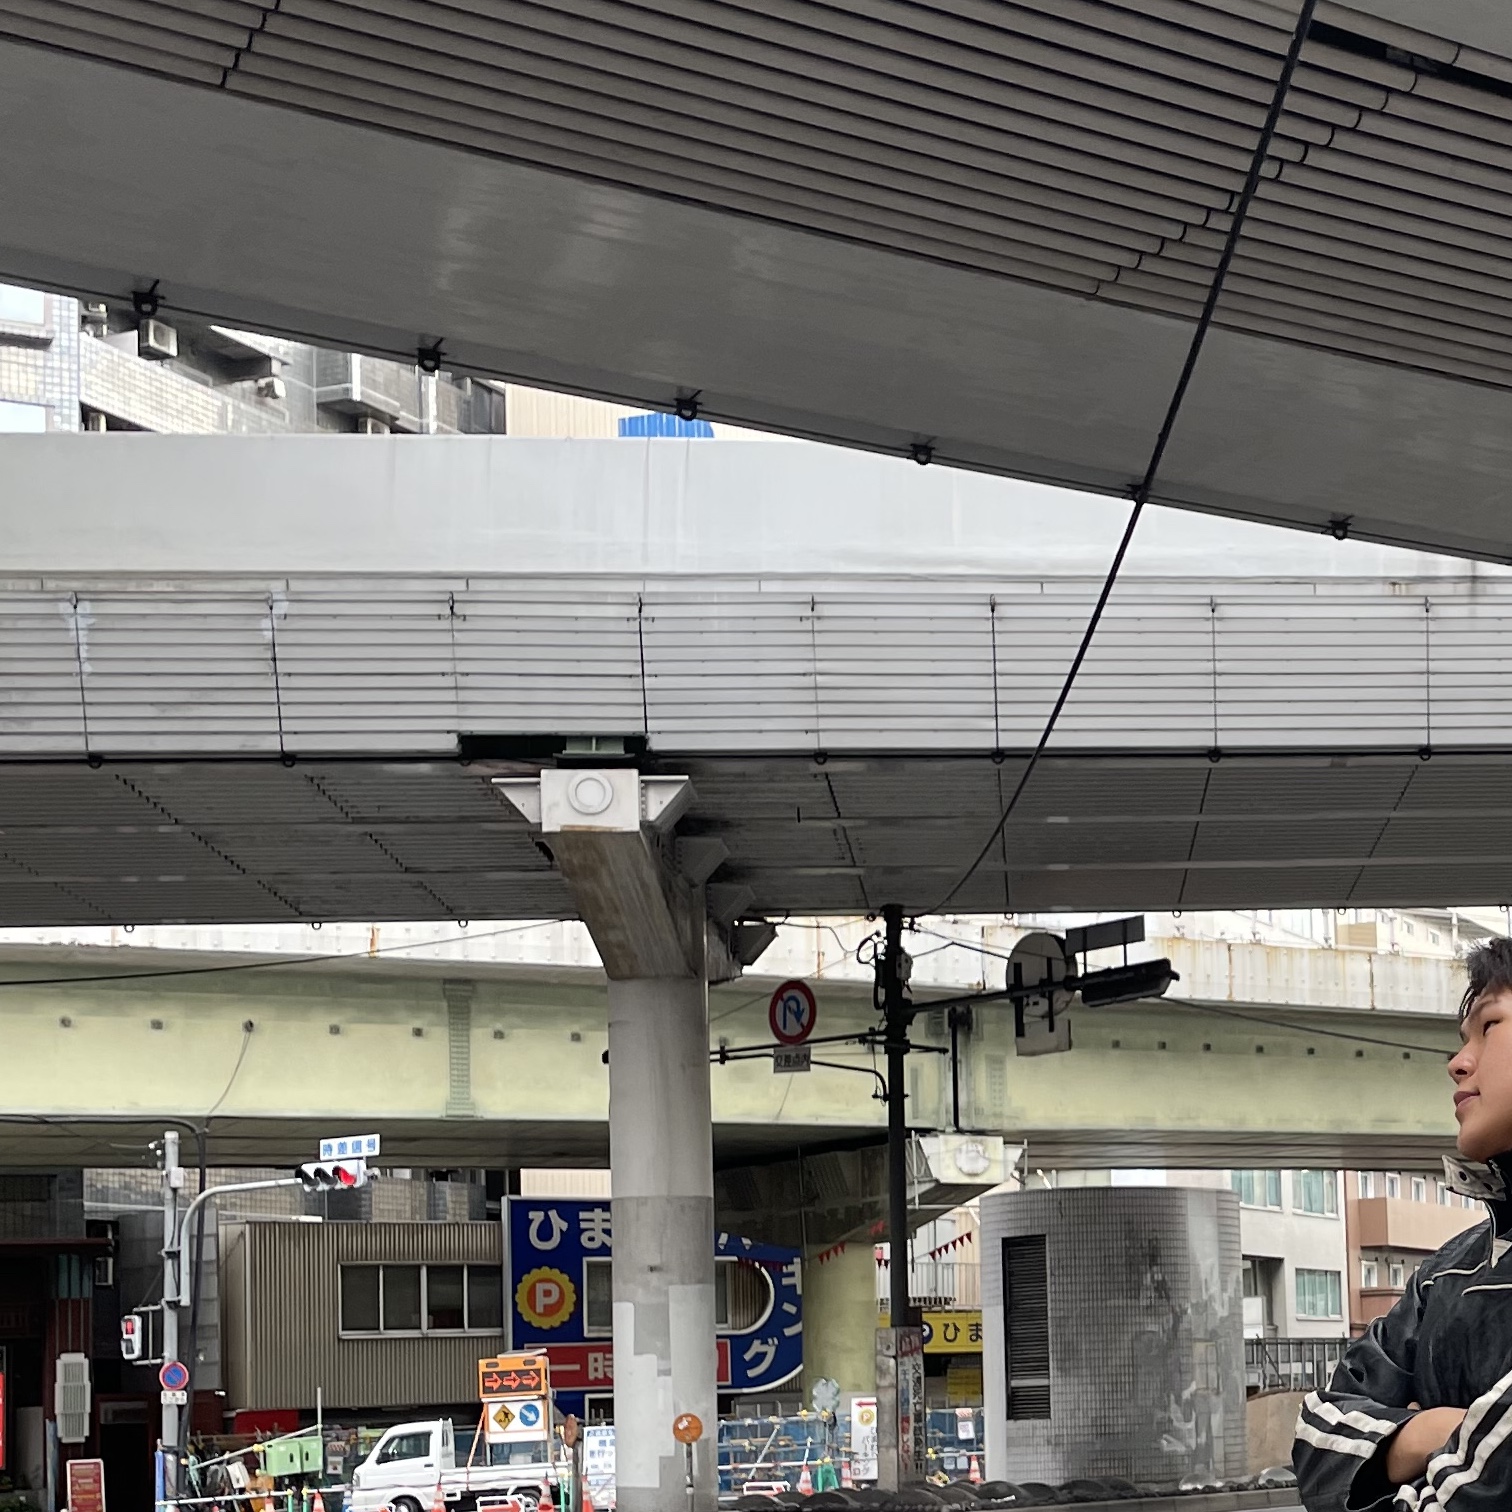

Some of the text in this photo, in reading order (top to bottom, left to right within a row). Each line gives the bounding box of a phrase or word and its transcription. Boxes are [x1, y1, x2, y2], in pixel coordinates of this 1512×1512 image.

[322, 1138, 376, 1157] 時差信号
[535, 1282, 561, 1314] P
